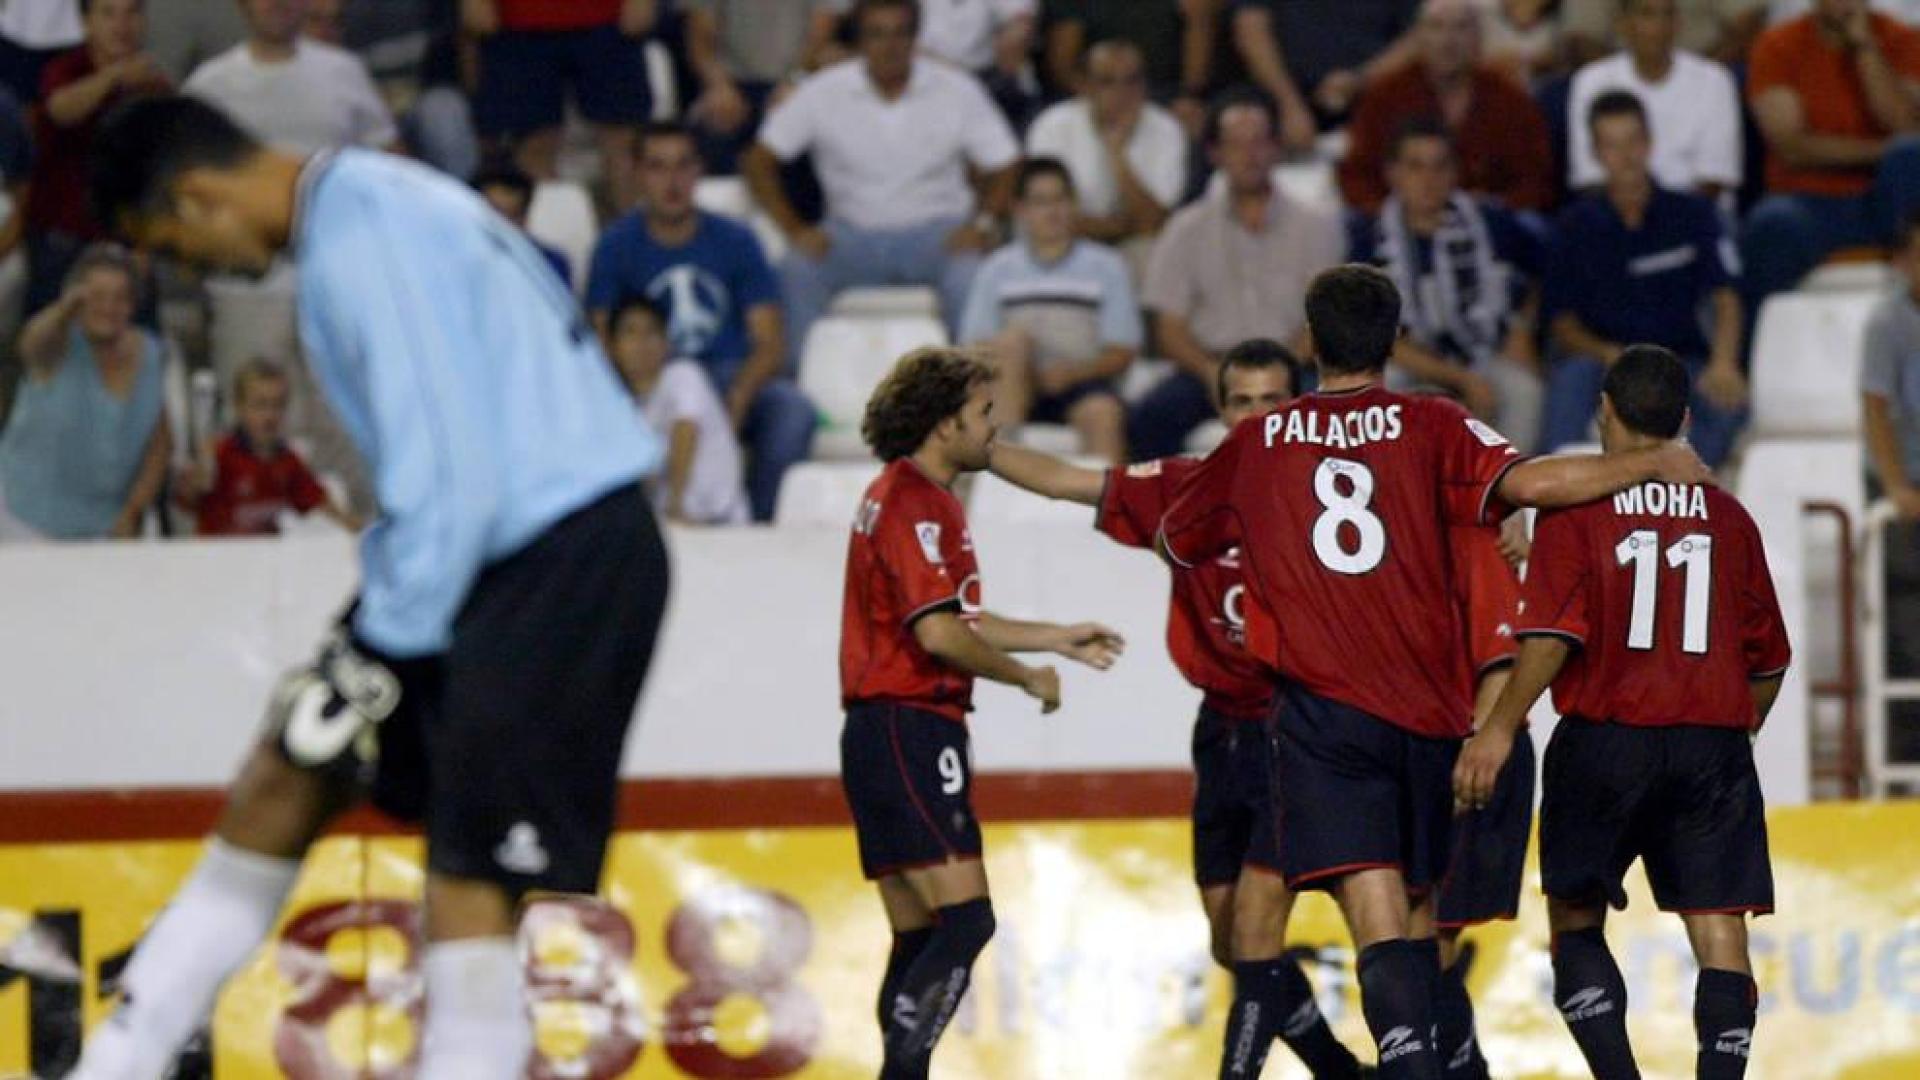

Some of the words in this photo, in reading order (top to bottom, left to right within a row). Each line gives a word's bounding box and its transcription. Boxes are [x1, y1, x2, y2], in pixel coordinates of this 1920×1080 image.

[1264, 403, 1402, 449] PALACIOS
[1312, 456, 1387, 576] 8
[1613, 481, 1708, 520] MOHA
[1614, 529, 1712, 655] 11
[938, 746, 964, 794] 9
